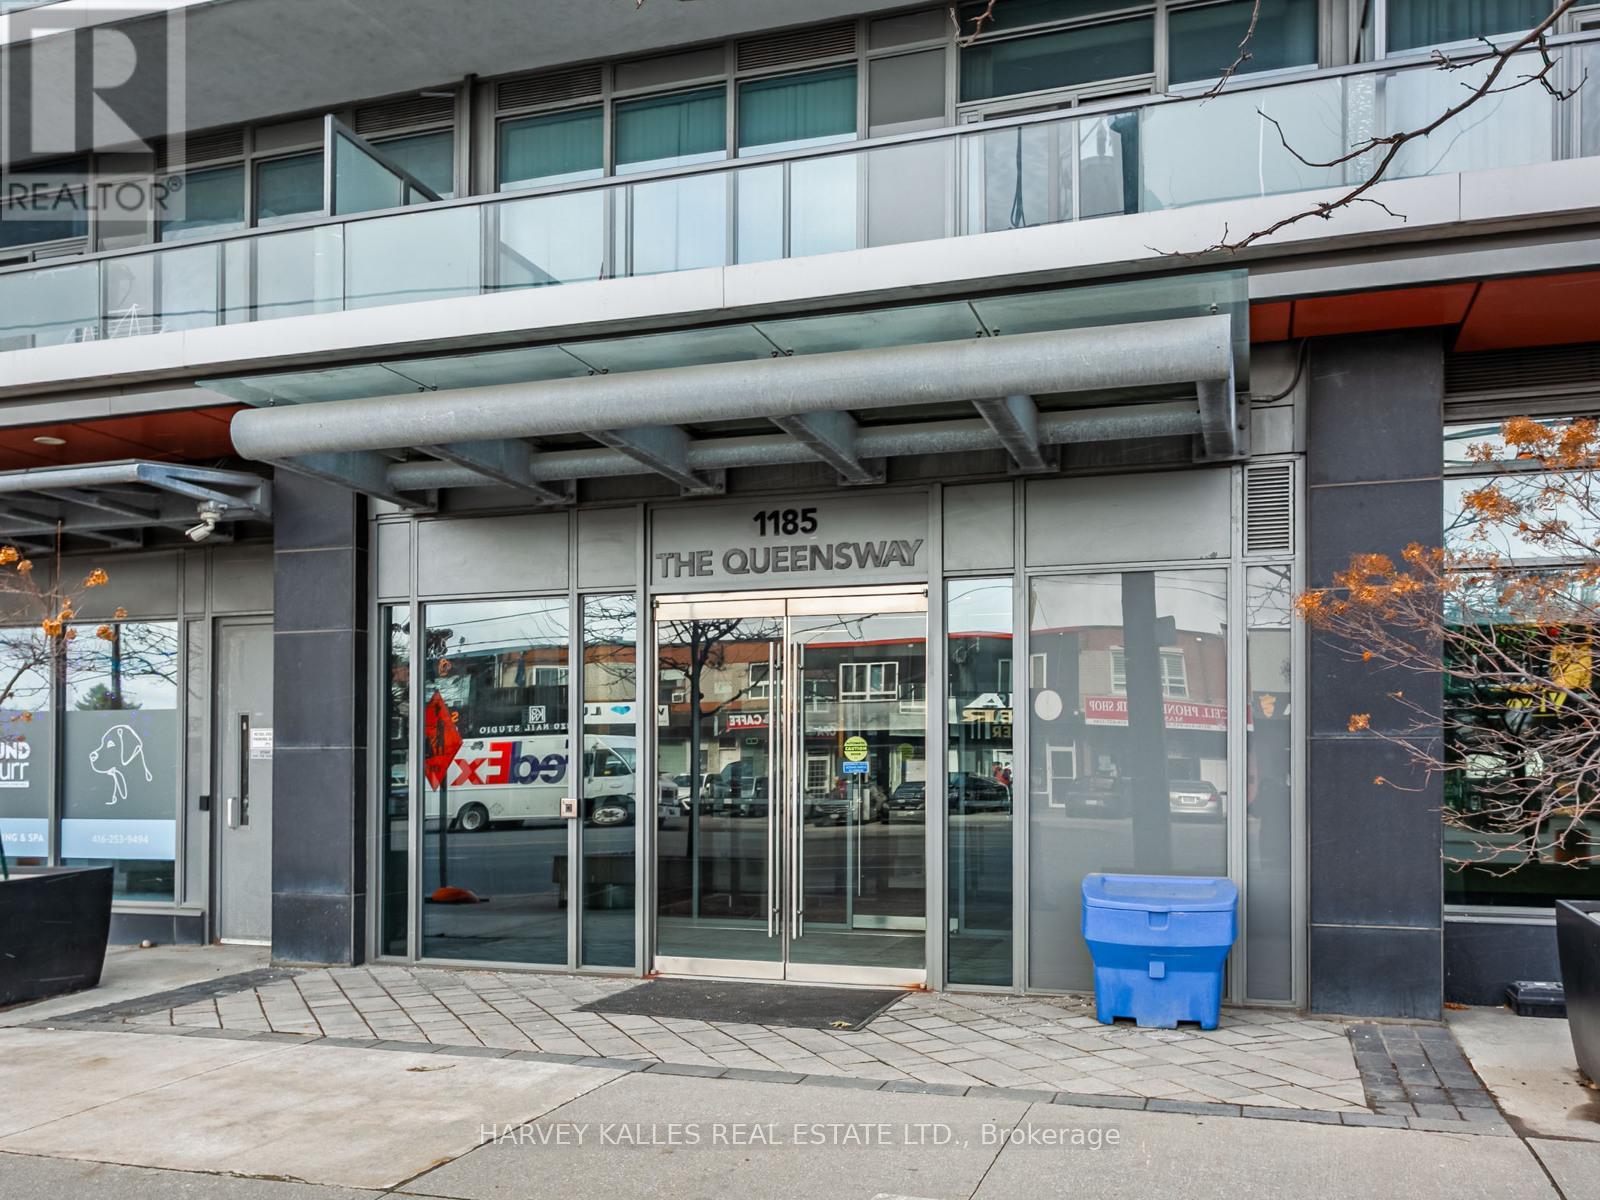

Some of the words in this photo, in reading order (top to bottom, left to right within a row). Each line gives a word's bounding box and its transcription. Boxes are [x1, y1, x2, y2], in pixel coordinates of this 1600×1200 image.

[753, 507, 819, 537] 1185
[655, 549, 714, 578] THE
[722, 538, 924, 575] QUEENSWAY
[27, 833, 45, 842] SPA
